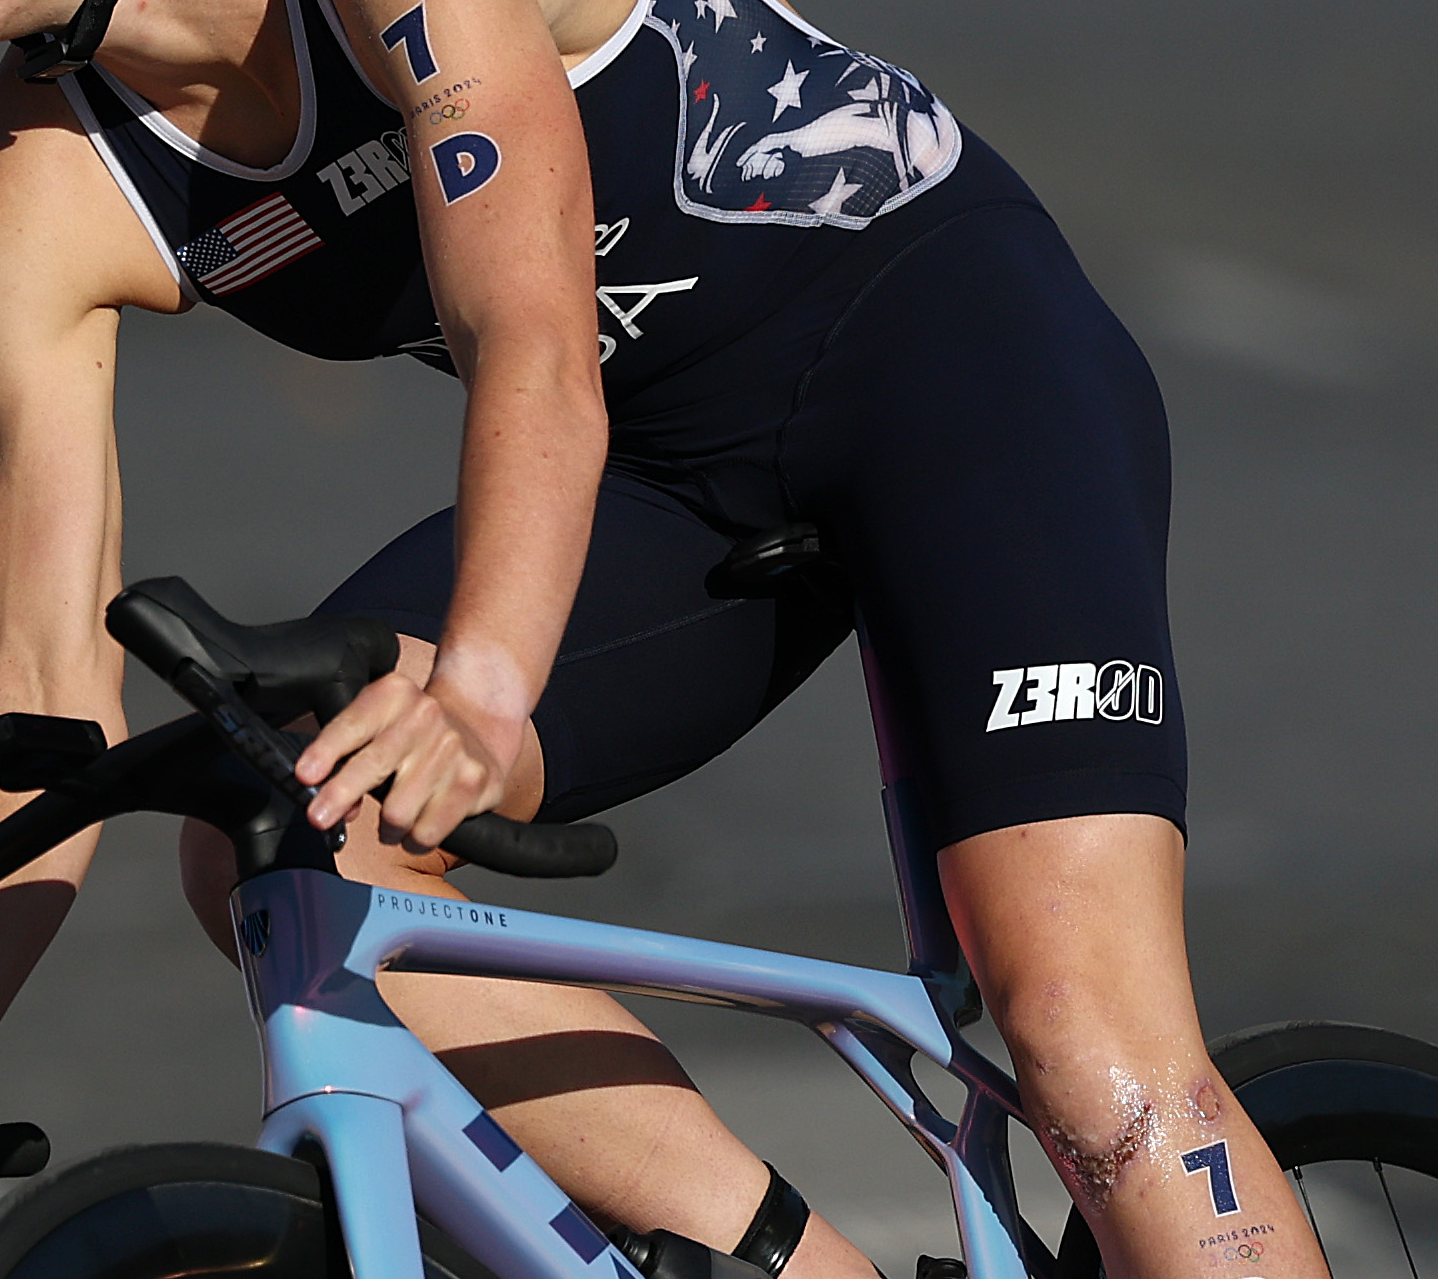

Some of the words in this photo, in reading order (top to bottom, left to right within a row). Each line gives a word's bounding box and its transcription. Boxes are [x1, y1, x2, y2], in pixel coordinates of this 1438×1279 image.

[429, 131, 502, 207] D
[1179, 1138, 1241, 1218] 7
[1199, 1230, 1239, 1249] PARIS
